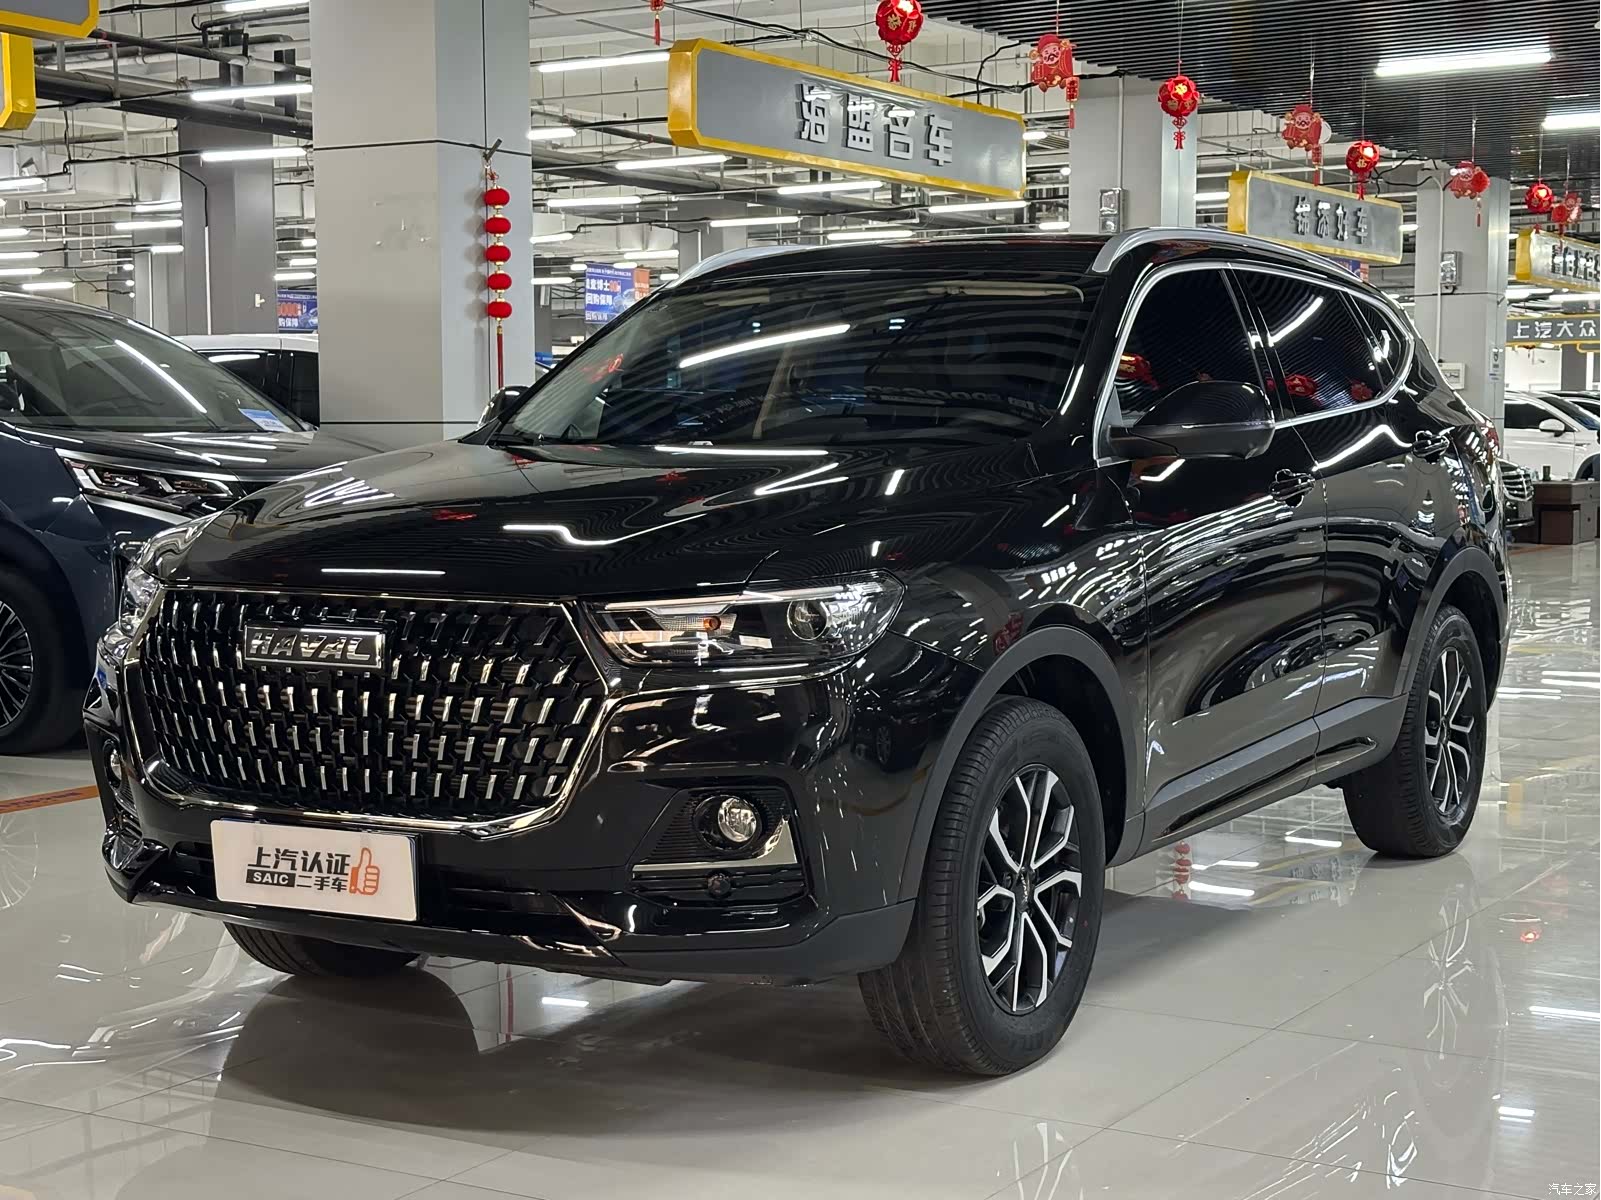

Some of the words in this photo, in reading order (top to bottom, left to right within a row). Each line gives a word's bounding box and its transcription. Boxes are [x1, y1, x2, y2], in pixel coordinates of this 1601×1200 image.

[1512, 320, 1597, 339] 上汽大众
[250, 632, 371, 661] HAVAL
[247, 846, 351, 876] 上汽认证
[252, 871, 290, 886] SAIC
[295, 874, 349, 892] 二手车
